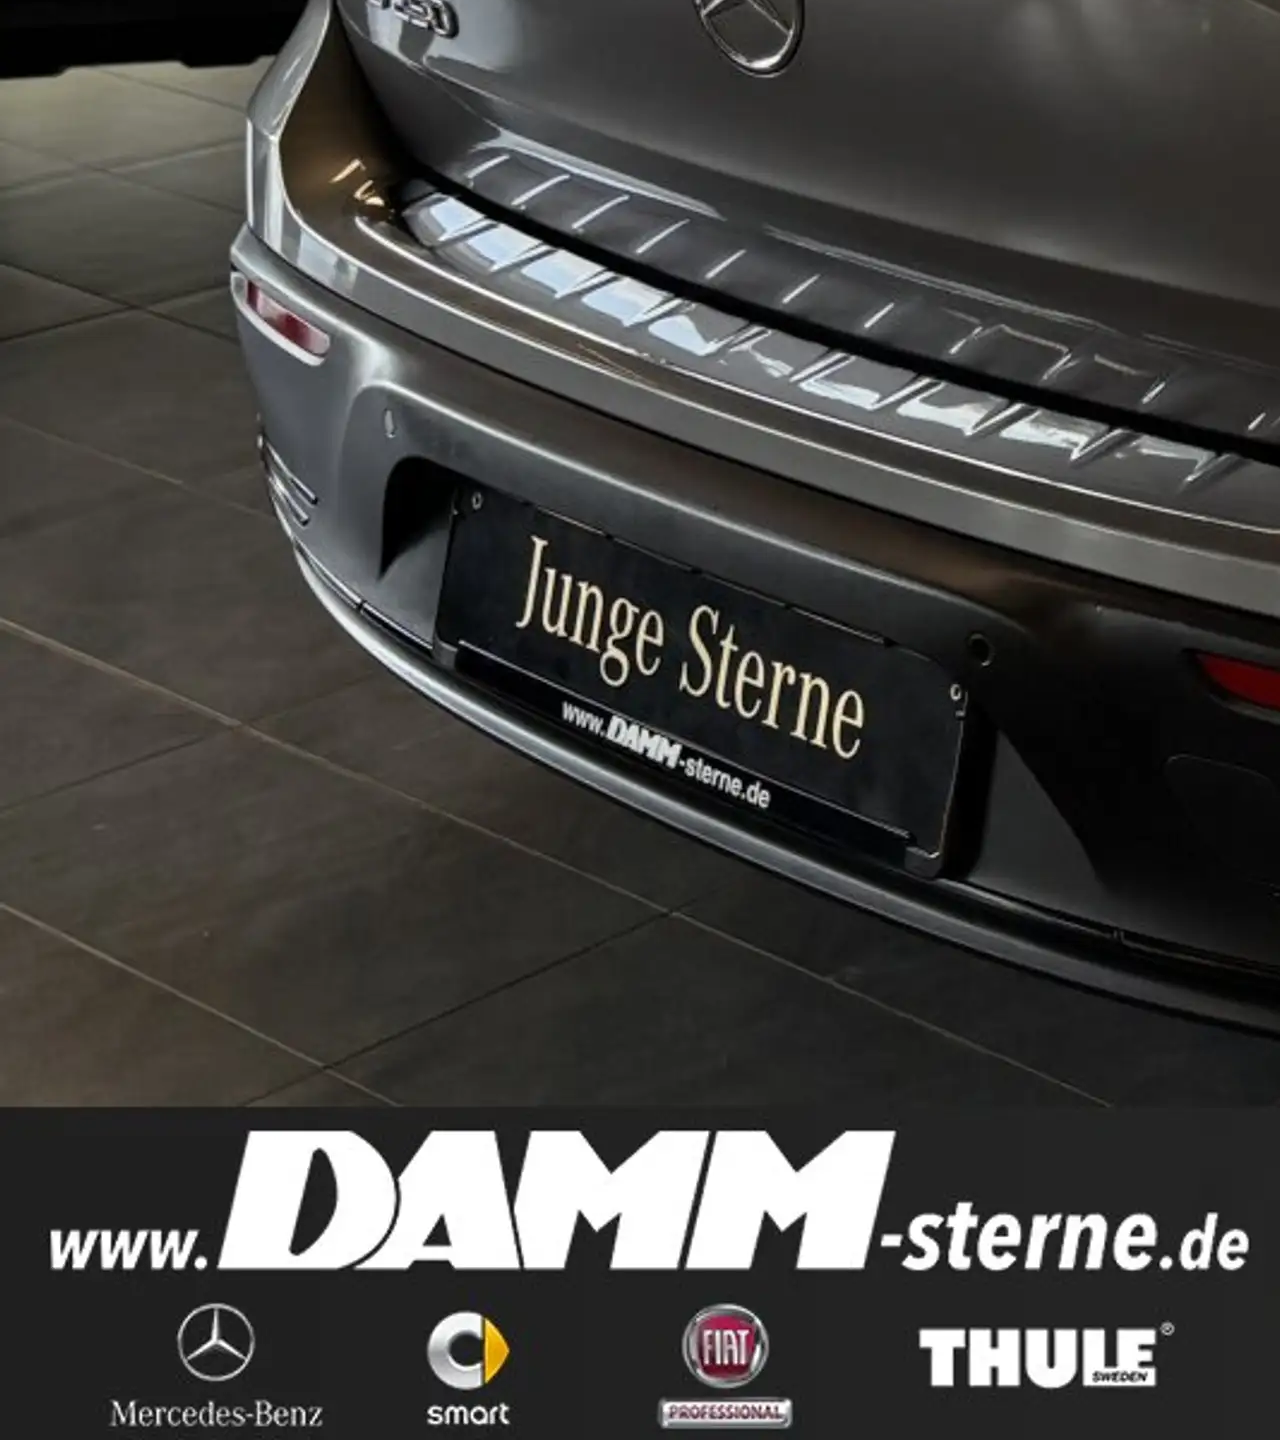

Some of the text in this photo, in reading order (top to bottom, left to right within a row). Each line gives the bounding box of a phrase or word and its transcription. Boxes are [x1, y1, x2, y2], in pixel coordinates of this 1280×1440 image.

[516, 535, 866, 759] Junge Sterne
[562, 701, 771, 809] www.DAMM-sterne.de
